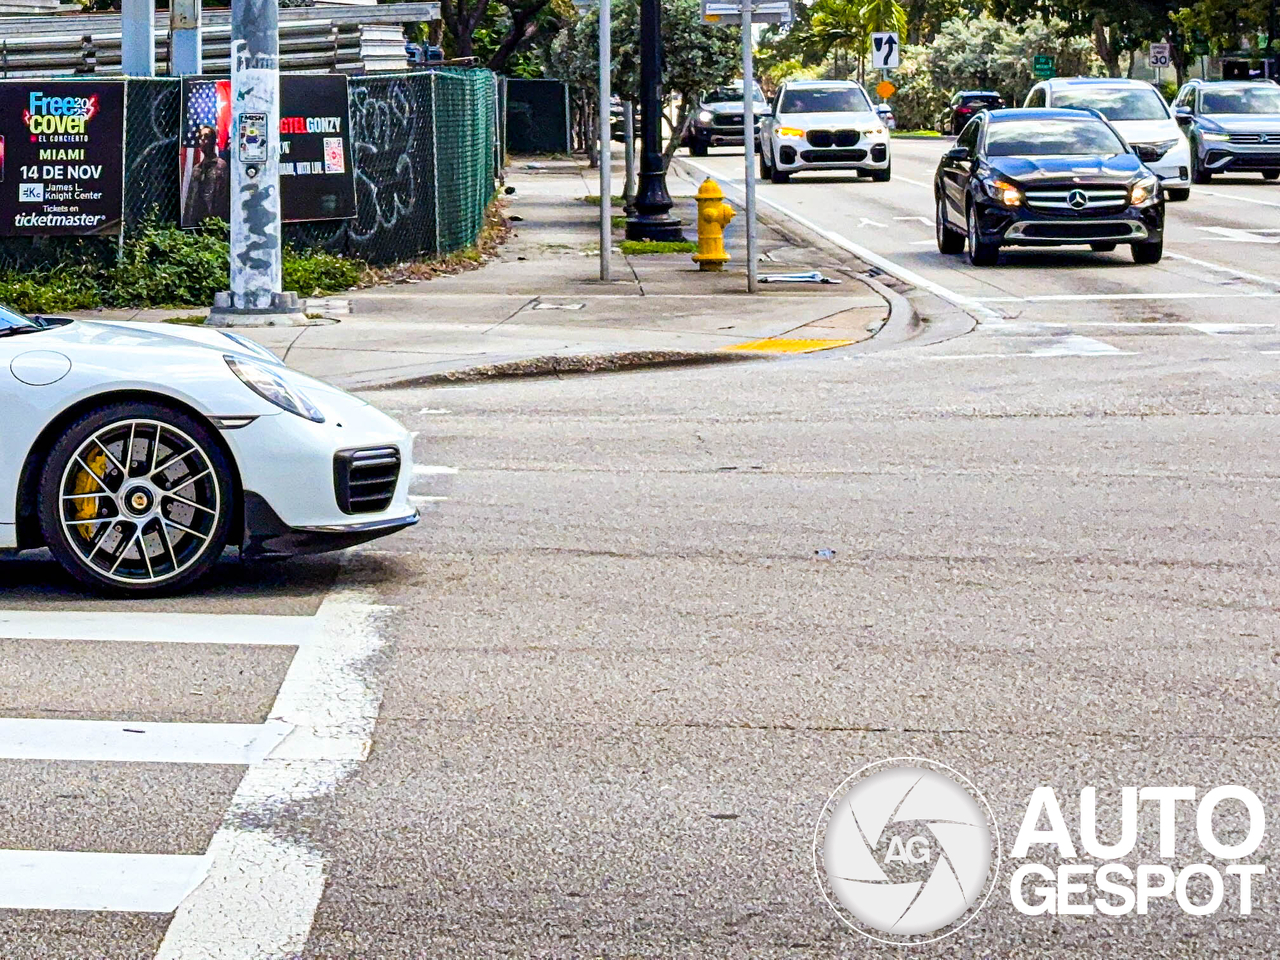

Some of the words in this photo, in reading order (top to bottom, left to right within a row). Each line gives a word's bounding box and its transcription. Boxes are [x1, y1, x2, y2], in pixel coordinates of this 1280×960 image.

[1151, 55, 1167, 65] 30
[29, 91, 75, 116] Free
[29, 114, 86, 134] cover
[39, 134, 47, 142] EL
[50, 134, 89, 142] CONCIERTO
[40, 149, 85, 160] MIAMI
[20, 165, 39, 179] 14
[42, 165, 64, 179] DE
[67, 165, 102, 179] NOV
[46, 183, 73, 192] James
[45, 191, 72, 201] Knight
[74, 191, 103, 200] Center
[42, 205, 68, 213] Tickets
